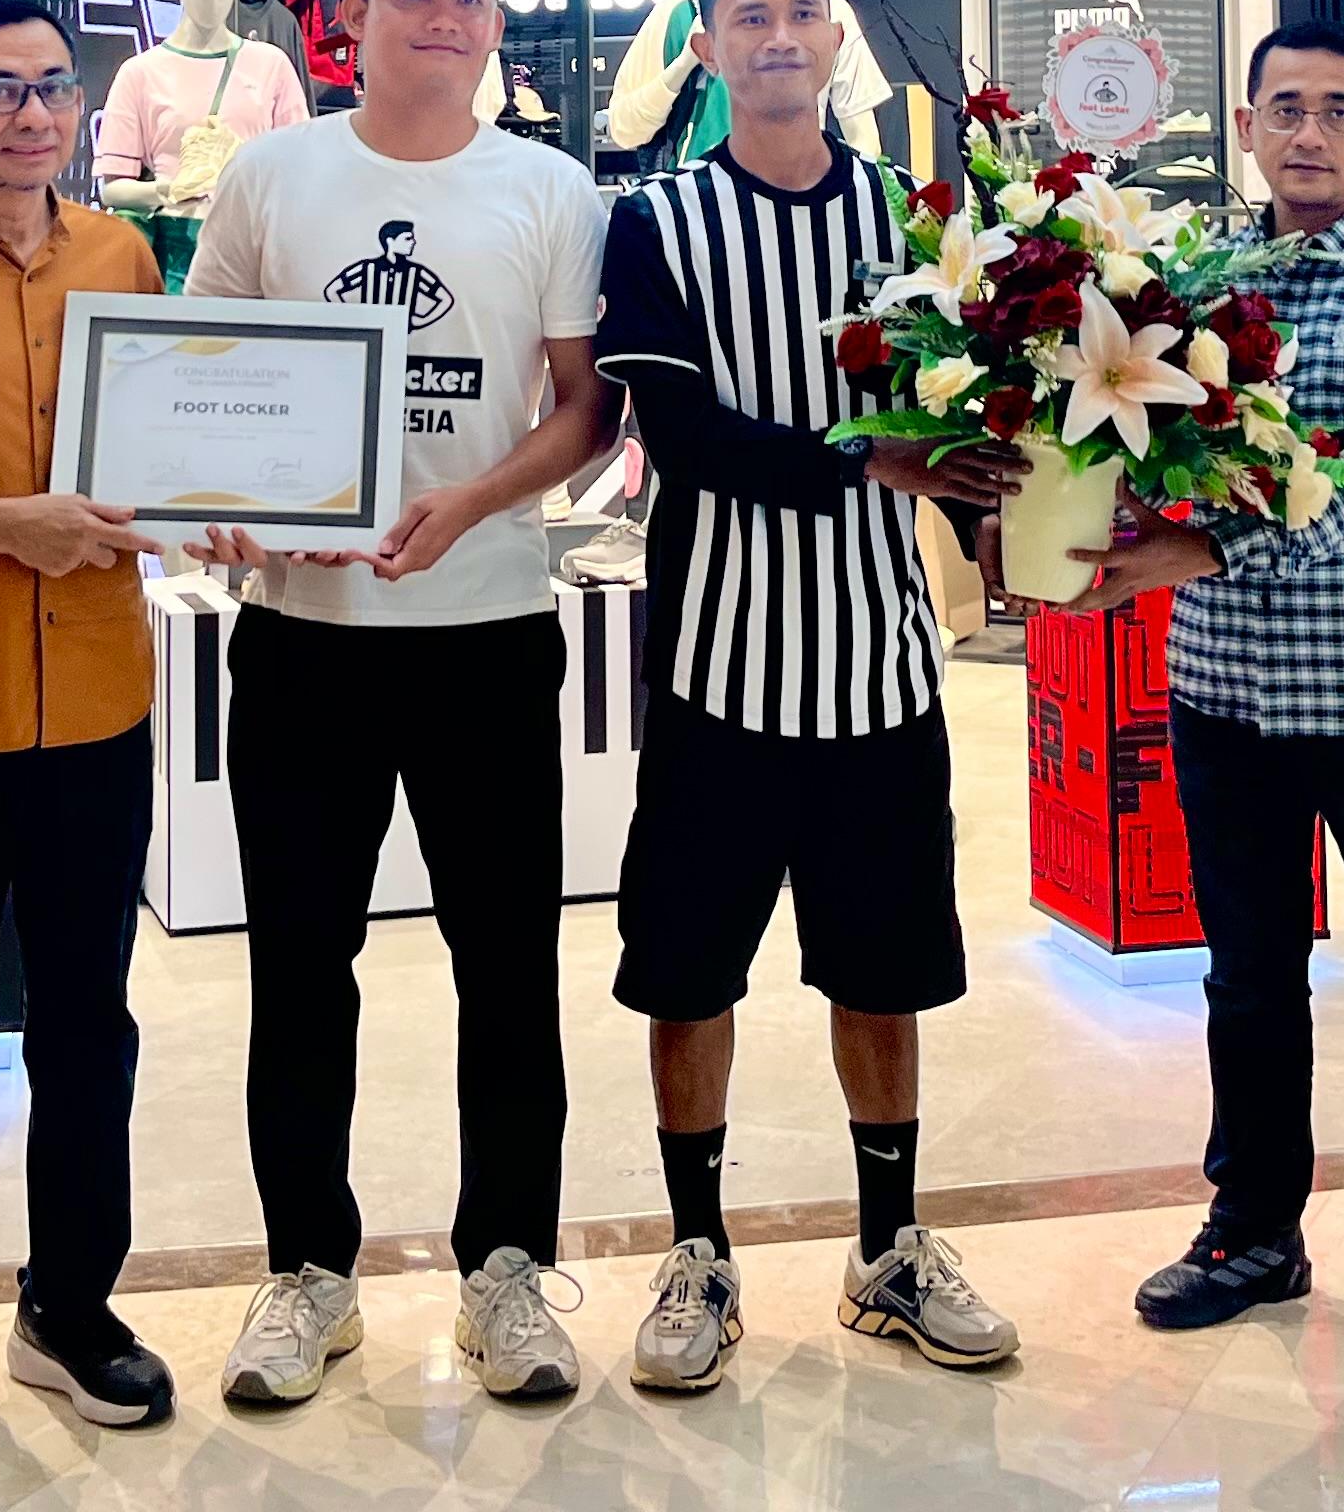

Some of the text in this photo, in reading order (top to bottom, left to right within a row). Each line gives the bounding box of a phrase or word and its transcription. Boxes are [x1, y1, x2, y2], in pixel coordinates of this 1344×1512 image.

[174, 401, 290, 416] FOOT LOCKER
[403, 407, 455, 434] SIA
